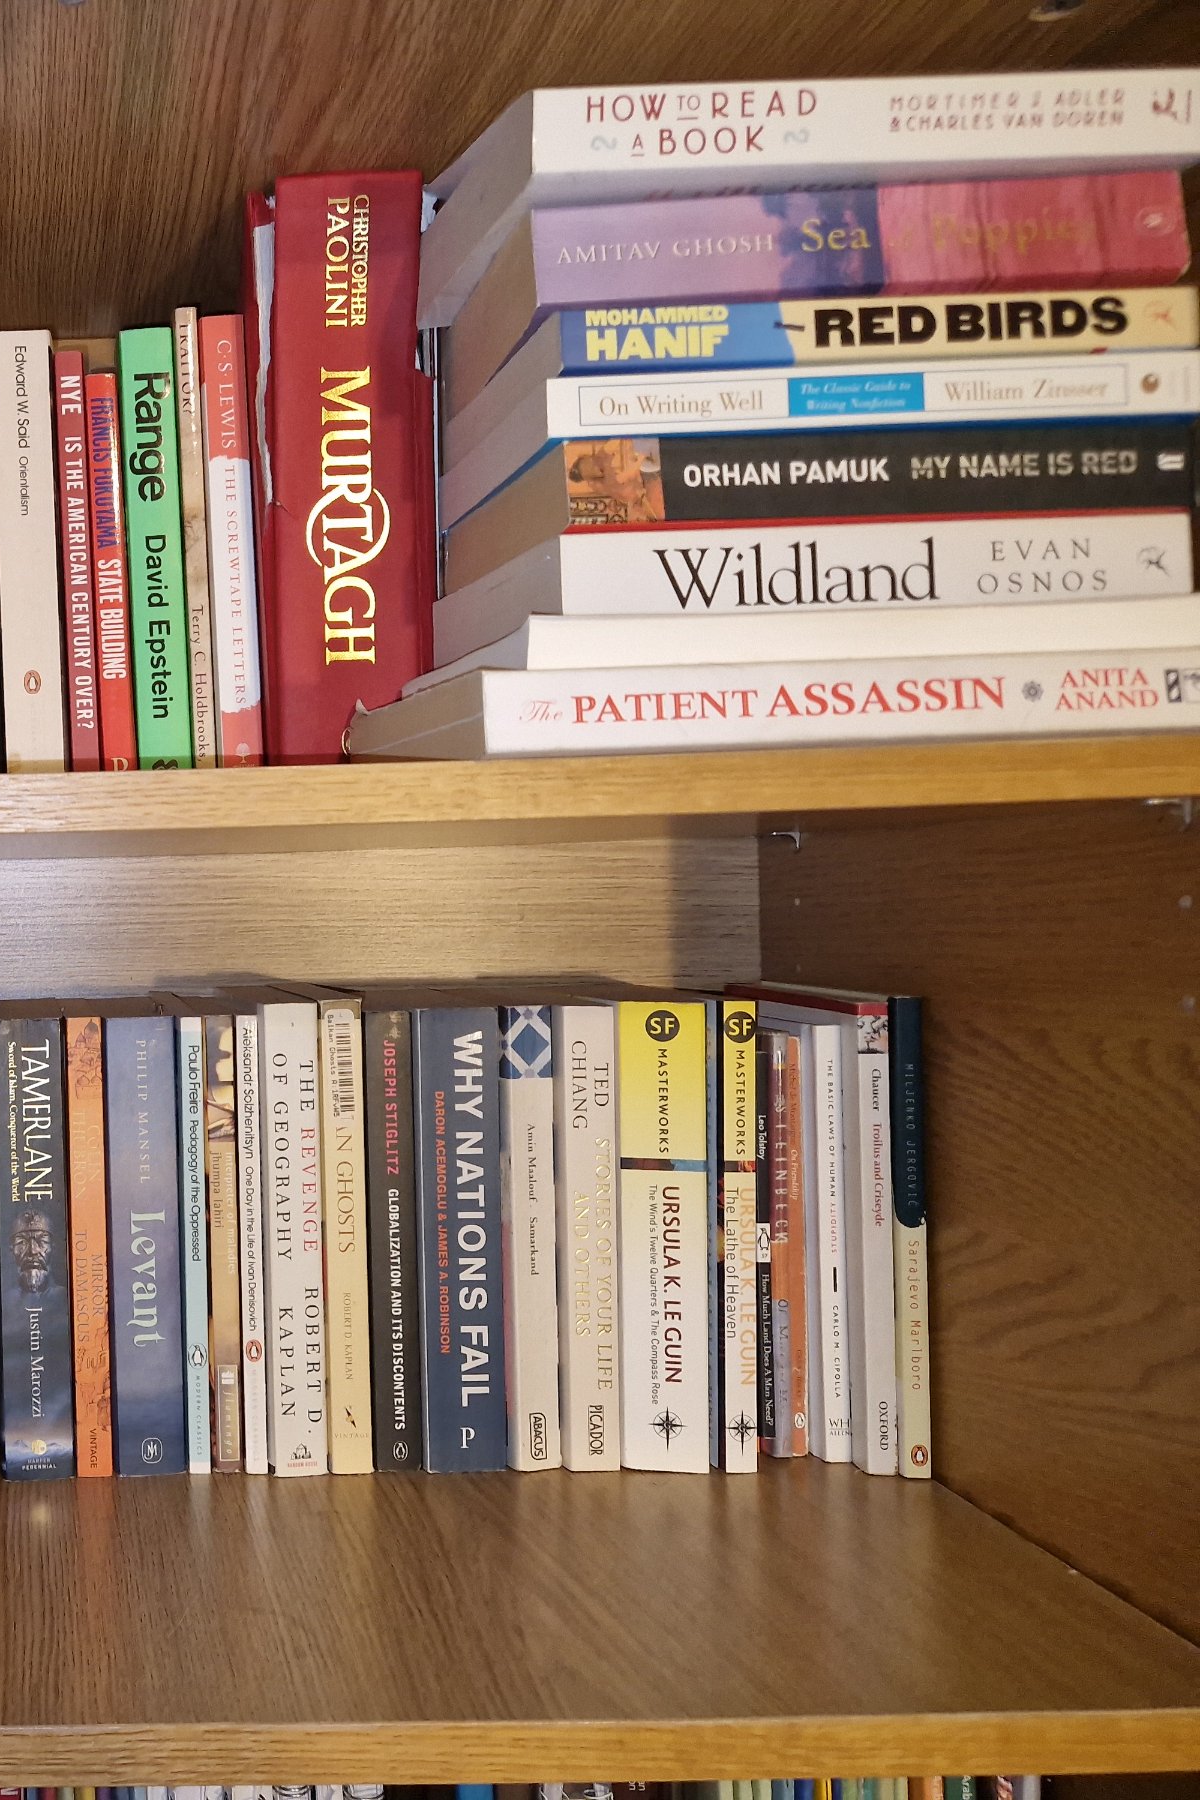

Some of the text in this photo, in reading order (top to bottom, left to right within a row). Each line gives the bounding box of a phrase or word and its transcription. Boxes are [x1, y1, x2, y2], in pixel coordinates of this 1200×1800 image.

[586, 89, 818, 123] HOW TO READ
[632, 125, 765, 156] A BOOK
[325, 197, 351, 329] PAOLINI
[350, 195, 370, 328] CHRISTOPHER
[557, 218, 872, 266] AMITAV GHOSH Sea
[585, 297, 1129, 362] MOHAMMED HANIF RED BIRDS
[310, 365, 387, 667] MURTAGH
[683, 450, 1139, 489] ORHAN PAMUK MY NAME IS RED
[60, 375, 95, 731] NYE IS THE AMERICAN CENTURY OVER?
[130, 372, 175, 720] Range David Epstein
[652, 536, 942, 611] Wildland
[977, 570, 1108, 595] OSNOS
[990, 538, 1091, 562] EVAN
[519, 677, 1007, 725] The PATIENT ASSASSIN
[1055, 689, 1160, 713] ANAND
[1061, 668, 1150, 690] ANITA
[21, 1039, 53, 1203] TAMERLANE
[572, 1041, 588, 1131] CHIANG
[594, 1062, 610, 1108] TED
[658, 1048, 670, 1154] MASTERWORKS
[736, 1050, 746, 1156] MASTERWORKS
[272, 1053, 293, 1262] OF GEOGRAPHY
[300, 1060, 319, 1253] THE REVENGE
[383, 1041, 406, 1431] JOSEPH STIGLITZ GLOBALIZATION AND ITS DISCONTENTS
[452, 1031, 491, 1409] WHY NATIONS FAIL
[726, 1186, 740, 1340] The Lathe of Heaven
[92, 1254, 104, 1318] MIRROR
[126, 1210, 167, 1348] Levant
[649, 1185, 661, 1405] The Wind's Twelve Quarters & The Compass Rose
[662, 1187, 683, 1384] URSULA K. LE GUIN
[907, 1240, 922, 1391] Sarajevo Marlboro
[279, 1307, 296, 1418] KAPLAN
[89, 1428, 99, 1469] VINTAGE
[533, 1415, 545, 1458] ABACUS
[879, 1401, 890, 1452] OXFORD
